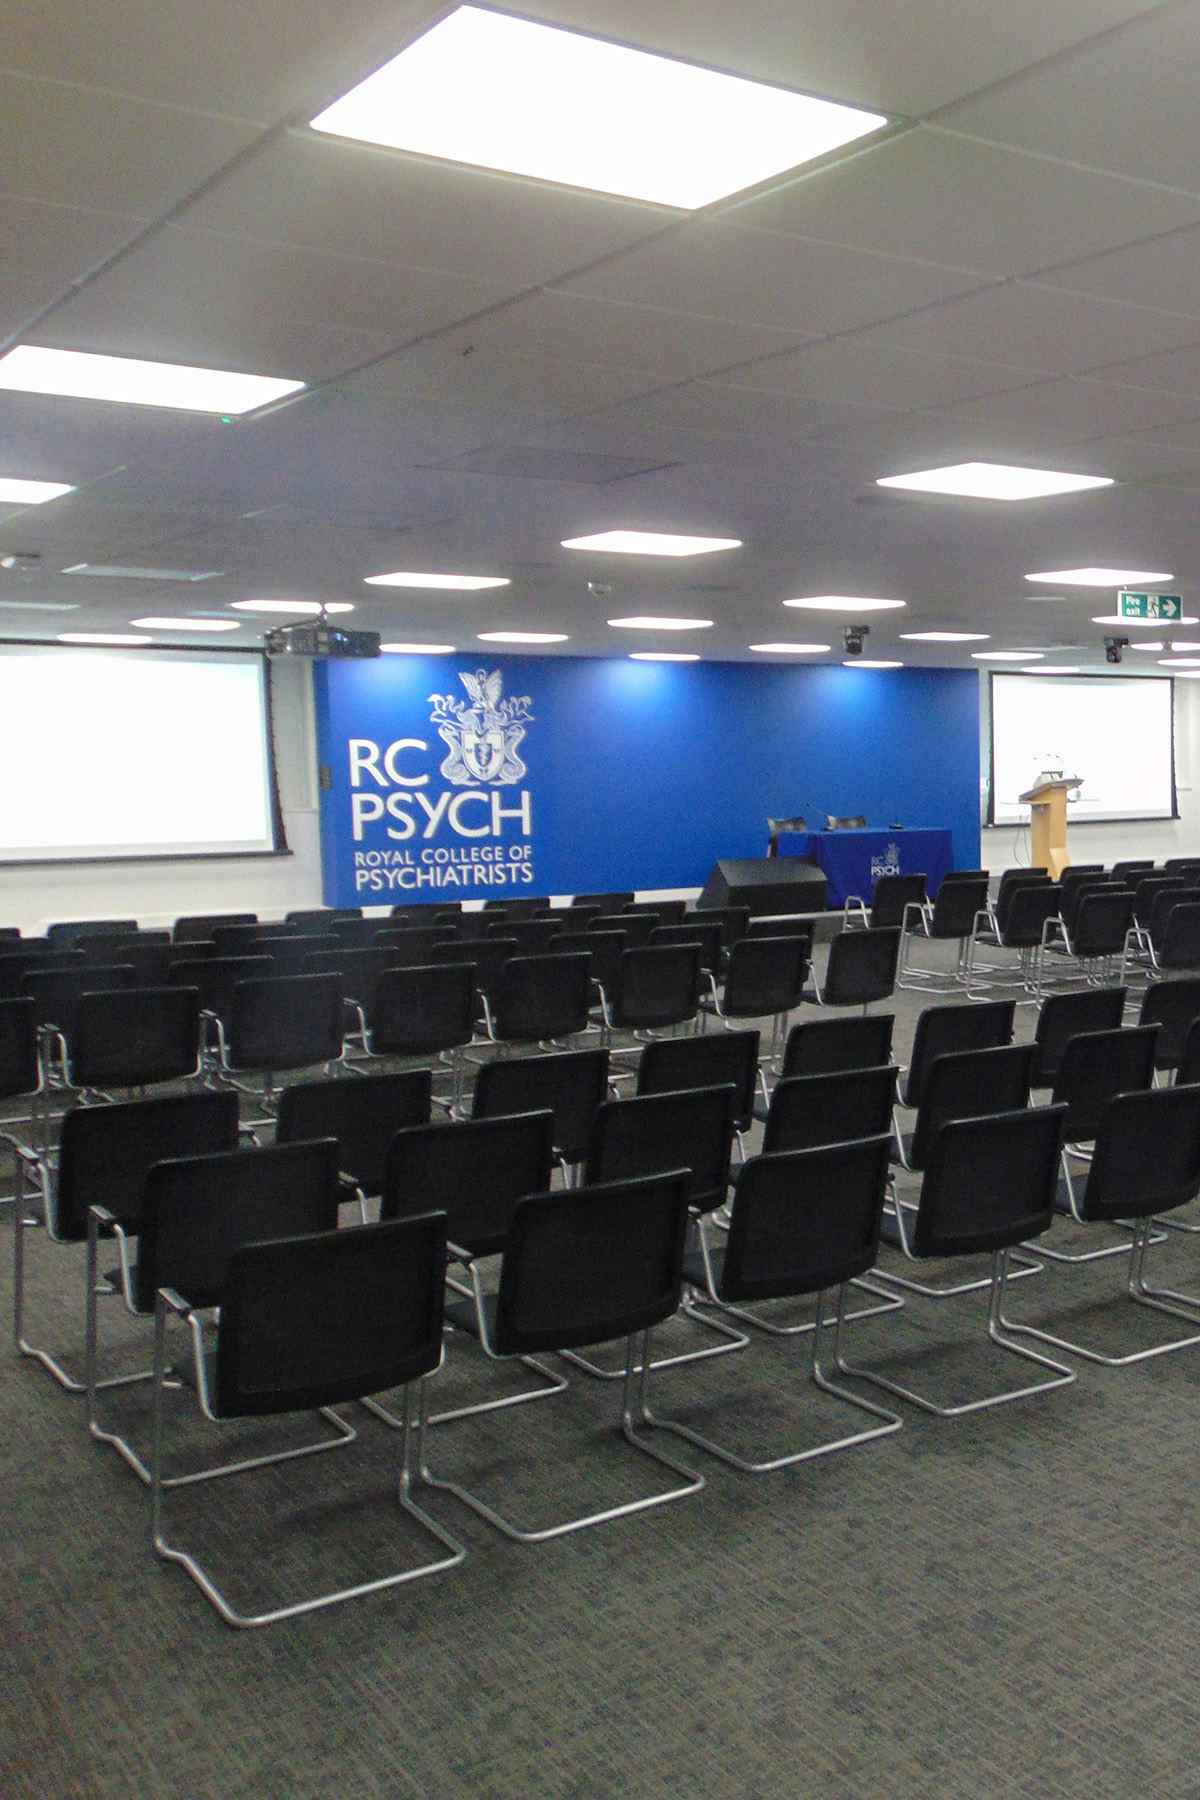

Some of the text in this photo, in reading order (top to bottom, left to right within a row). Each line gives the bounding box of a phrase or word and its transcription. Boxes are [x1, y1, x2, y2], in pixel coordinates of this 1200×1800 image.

[348, 738, 430, 787] RC
[351, 791, 531, 841] PSYCH
[354, 844, 532, 867] ROYAL COLLEGE OF
[355, 862, 533, 891] PSYCHIATRISTS
[871, 865, 900, 876] PSYCH
